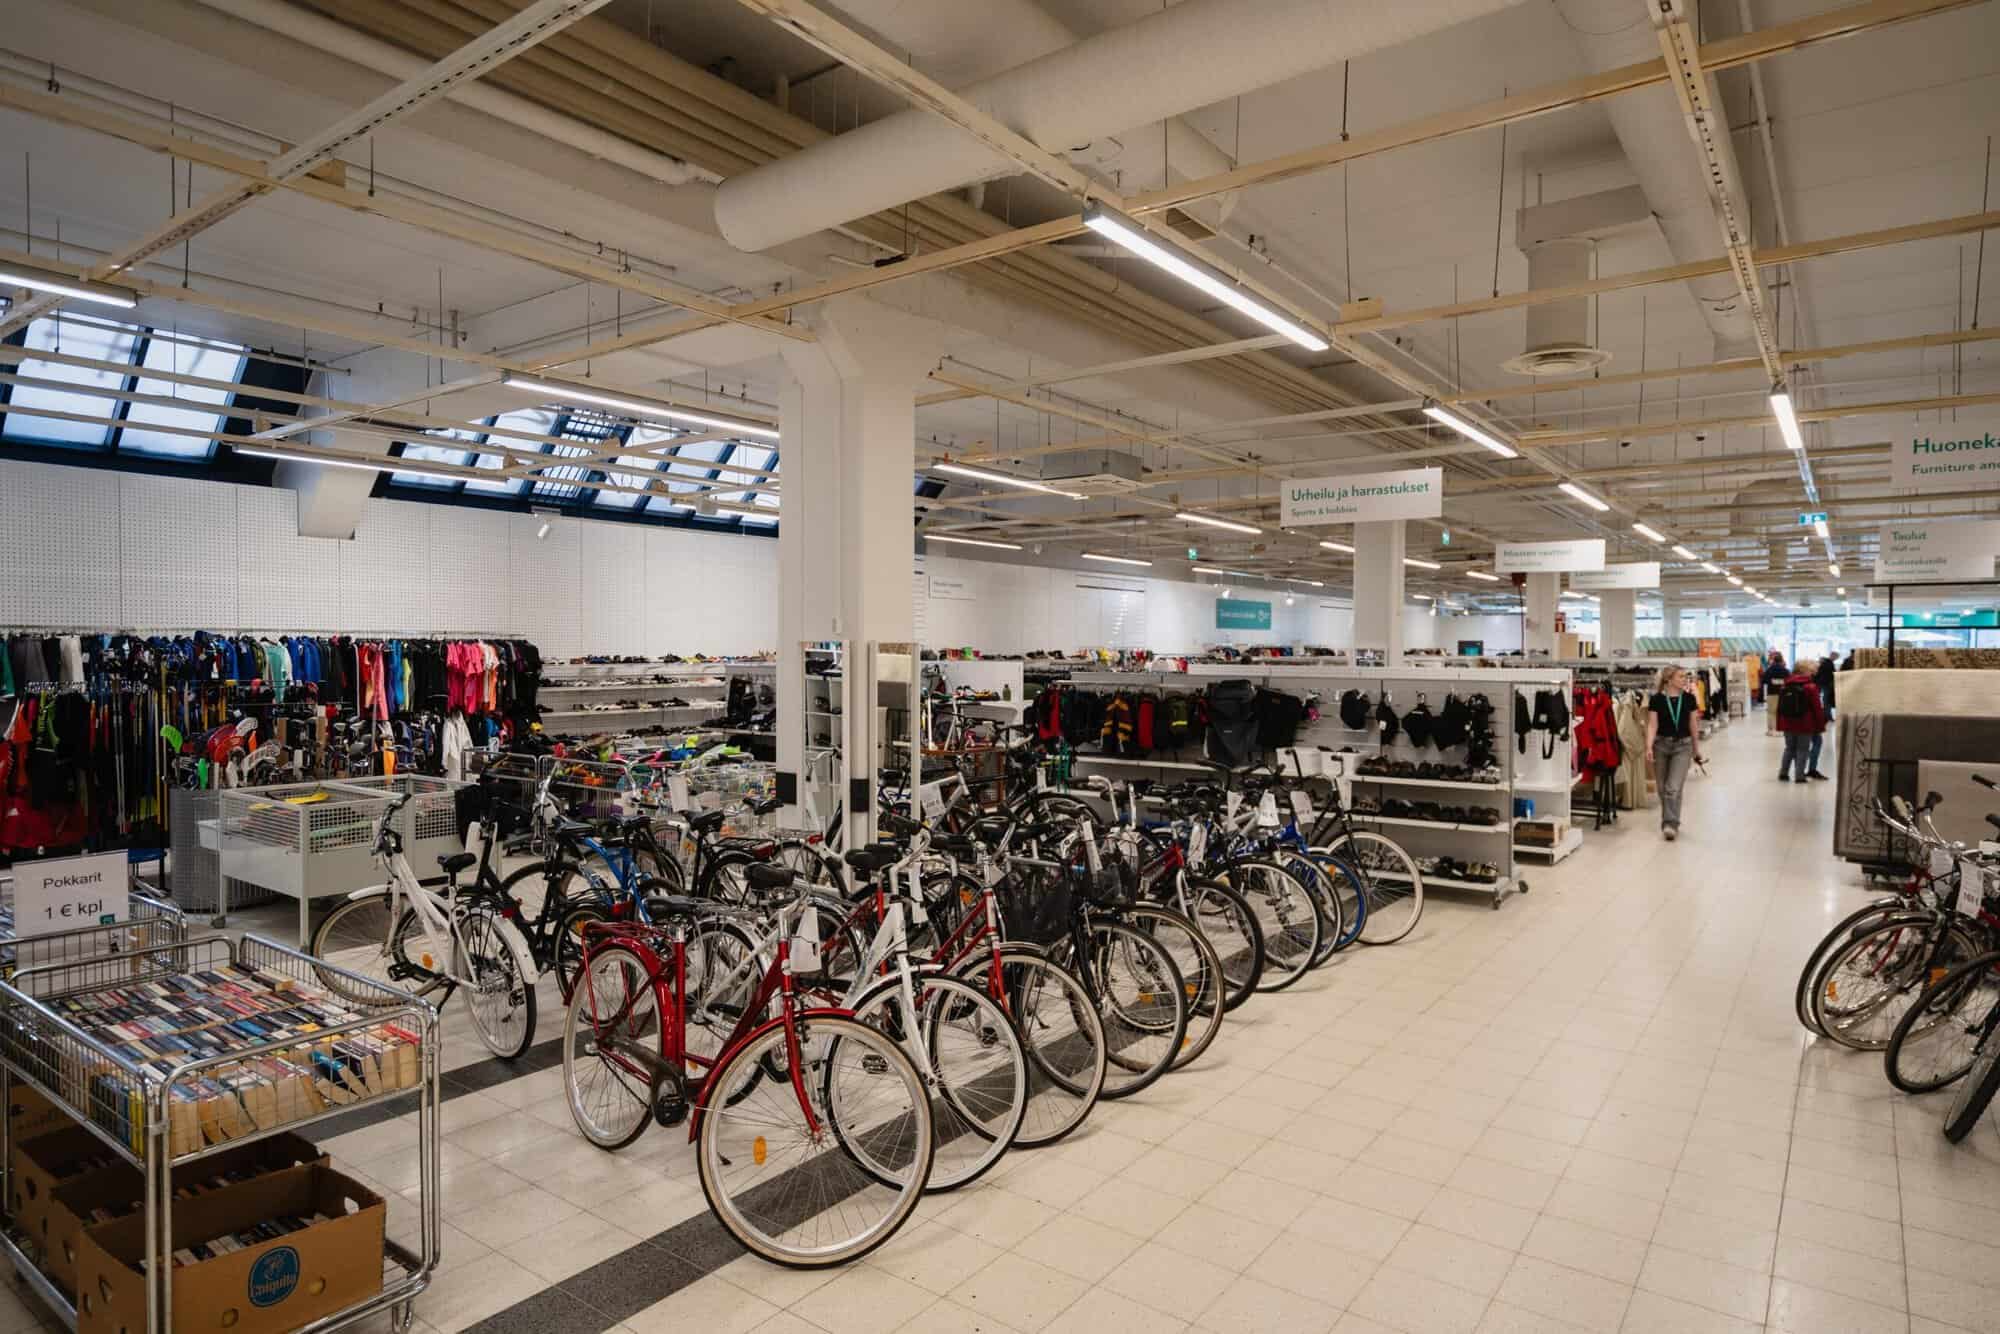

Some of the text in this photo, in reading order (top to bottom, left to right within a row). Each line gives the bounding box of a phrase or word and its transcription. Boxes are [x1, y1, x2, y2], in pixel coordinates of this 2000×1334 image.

[1911, 462, 1976, 476] Furniture
[1291, 481, 1430, 501] Urheilu ja harrastukset
[43, 871, 103, 889] Pokkarit
[44, 899, 103, 920] 1 € kpl
